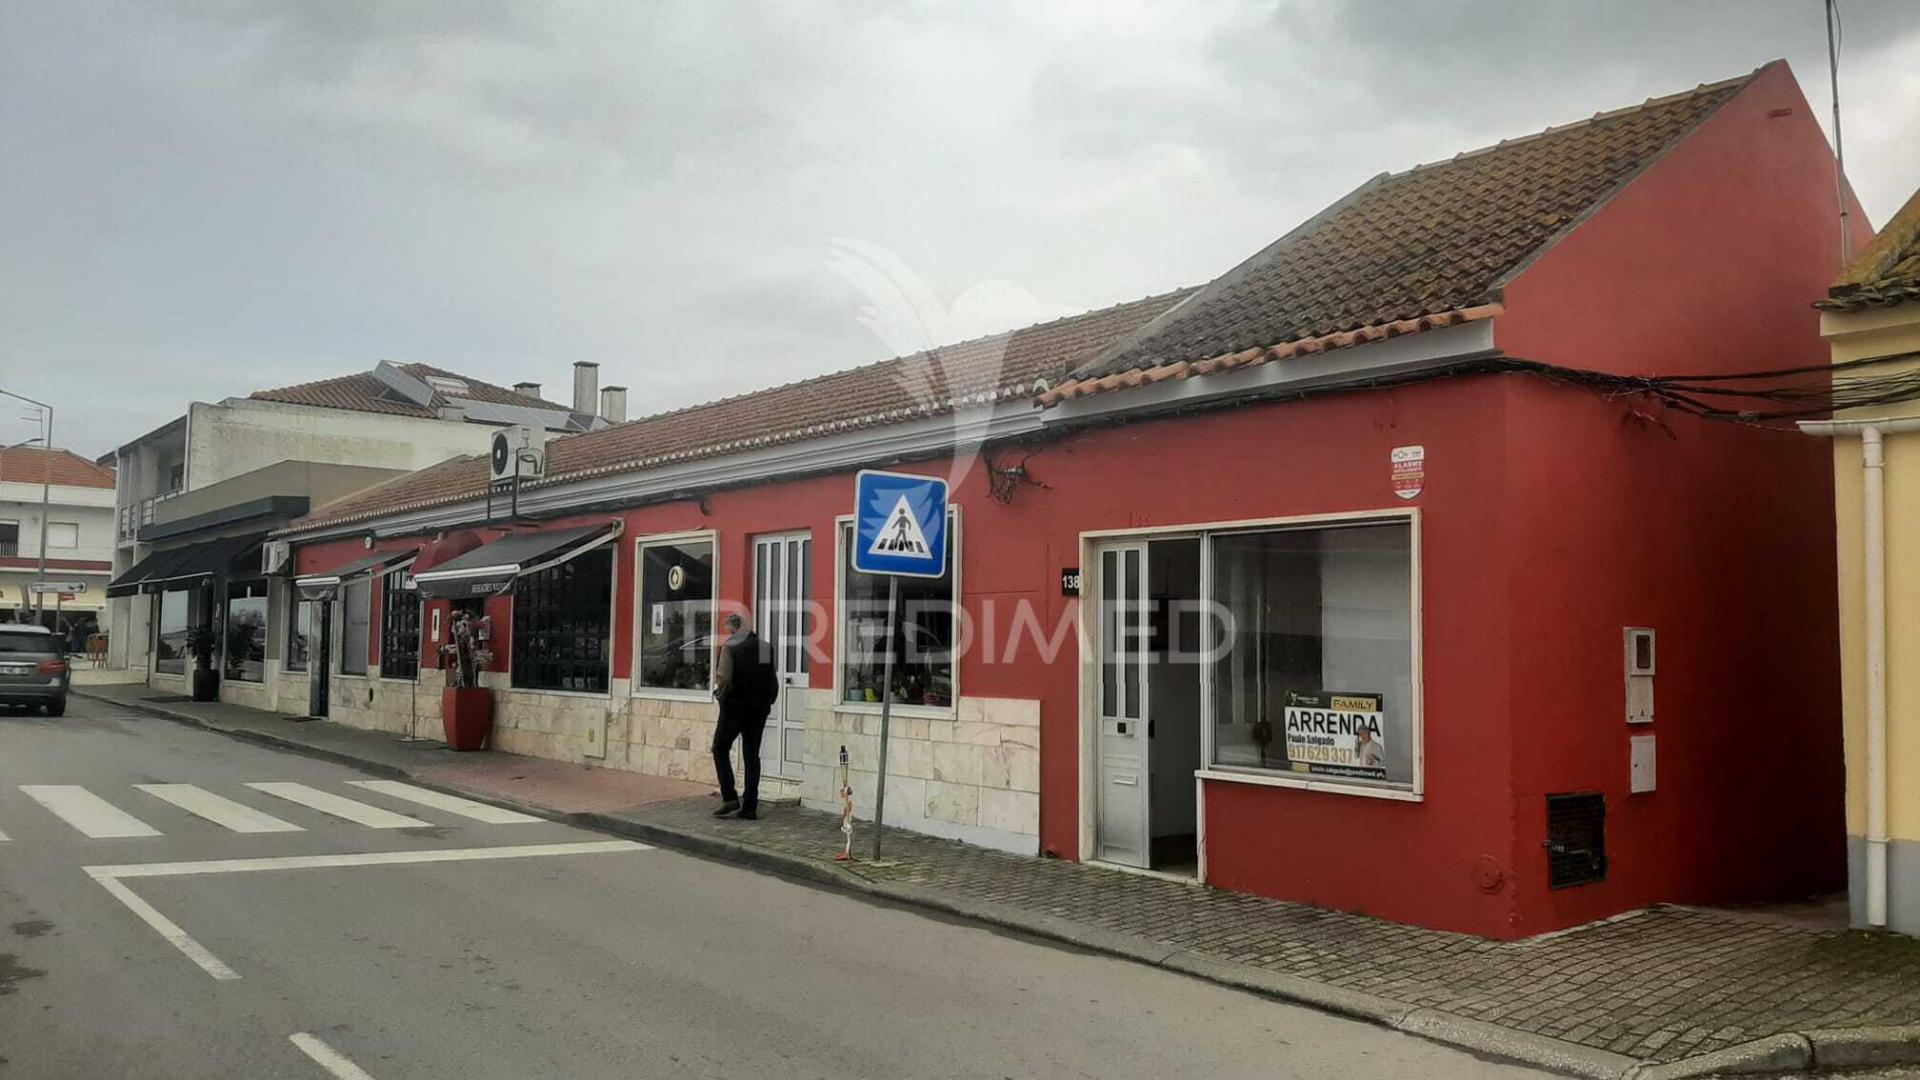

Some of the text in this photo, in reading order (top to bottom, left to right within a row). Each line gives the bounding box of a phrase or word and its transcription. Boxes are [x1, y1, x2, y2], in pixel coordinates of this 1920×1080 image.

[1062, 575, 1080, 589] 138
[1333, 699, 1374, 710] FAMILY
[1287, 710, 1381, 737] ARRENDA
[1287, 733, 1335, 746] Paulo Salgado
